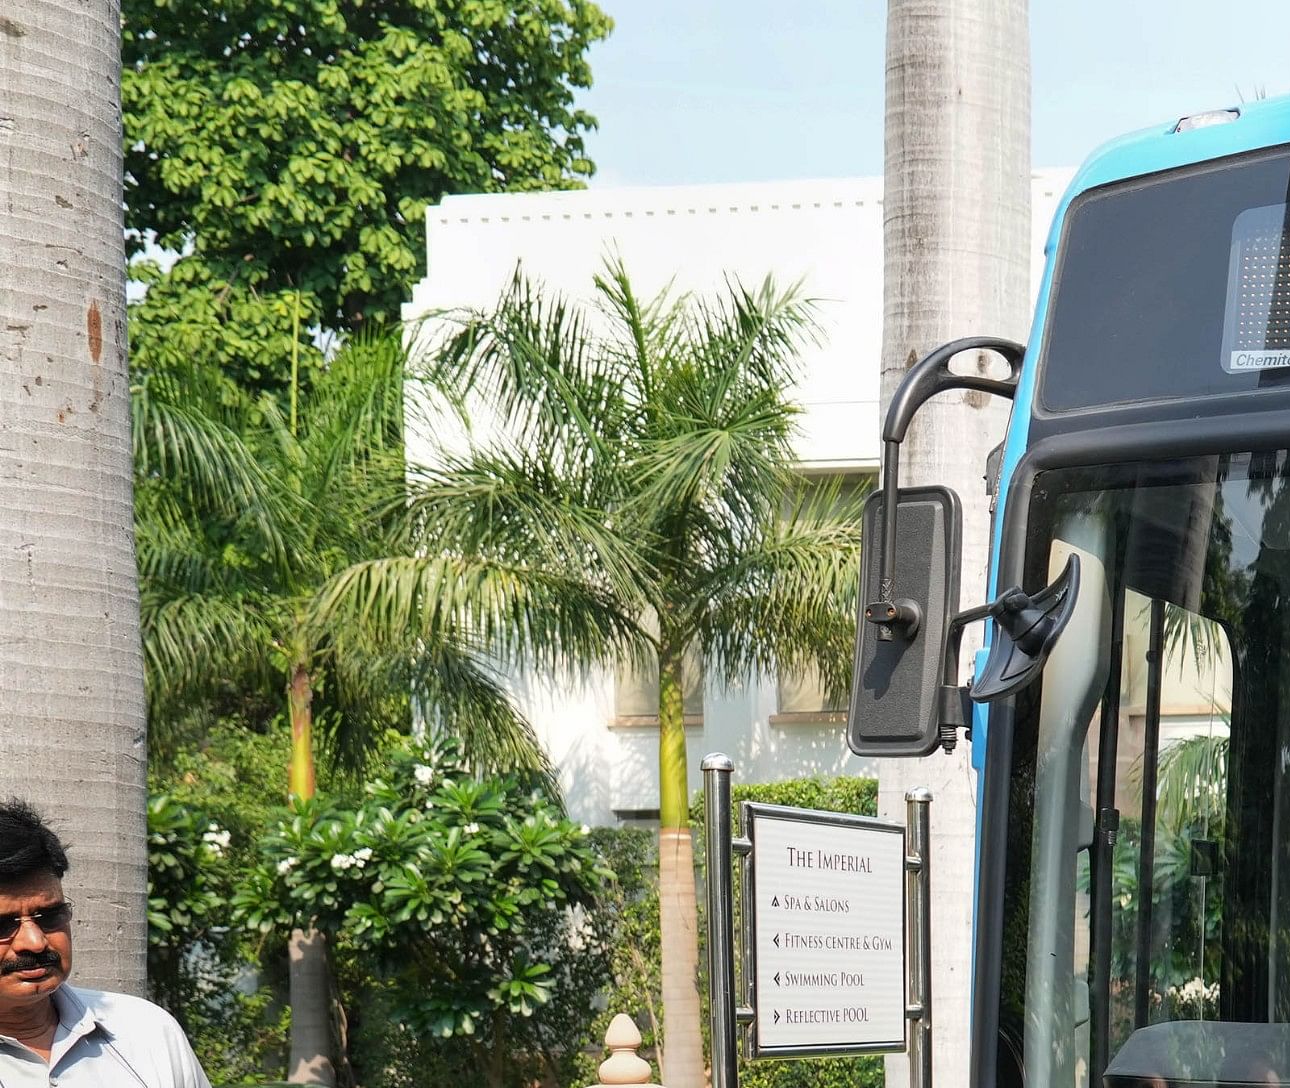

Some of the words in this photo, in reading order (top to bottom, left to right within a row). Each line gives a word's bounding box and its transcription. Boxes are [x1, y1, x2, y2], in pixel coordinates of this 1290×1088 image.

[787, 846, 814, 868] THE
[818, 850, 873, 873] IMPERIAL
[784, 894, 802, 910] SPA
[804, 895, 812, 911] &
[814, 896, 850, 913] SALONS
[785, 932, 823, 949] FITNESS
[825, 936, 860, 950] CENTRE
[863, 936, 871, 950] &
[872, 935, 893, 951] GYM
[785, 970, 838, 987] SWIMMING
[840, 972, 865, 987] POOL
[786, 1009, 840, 1024] REFLECTIVE
[843, 1007, 869, 1022] POOL
